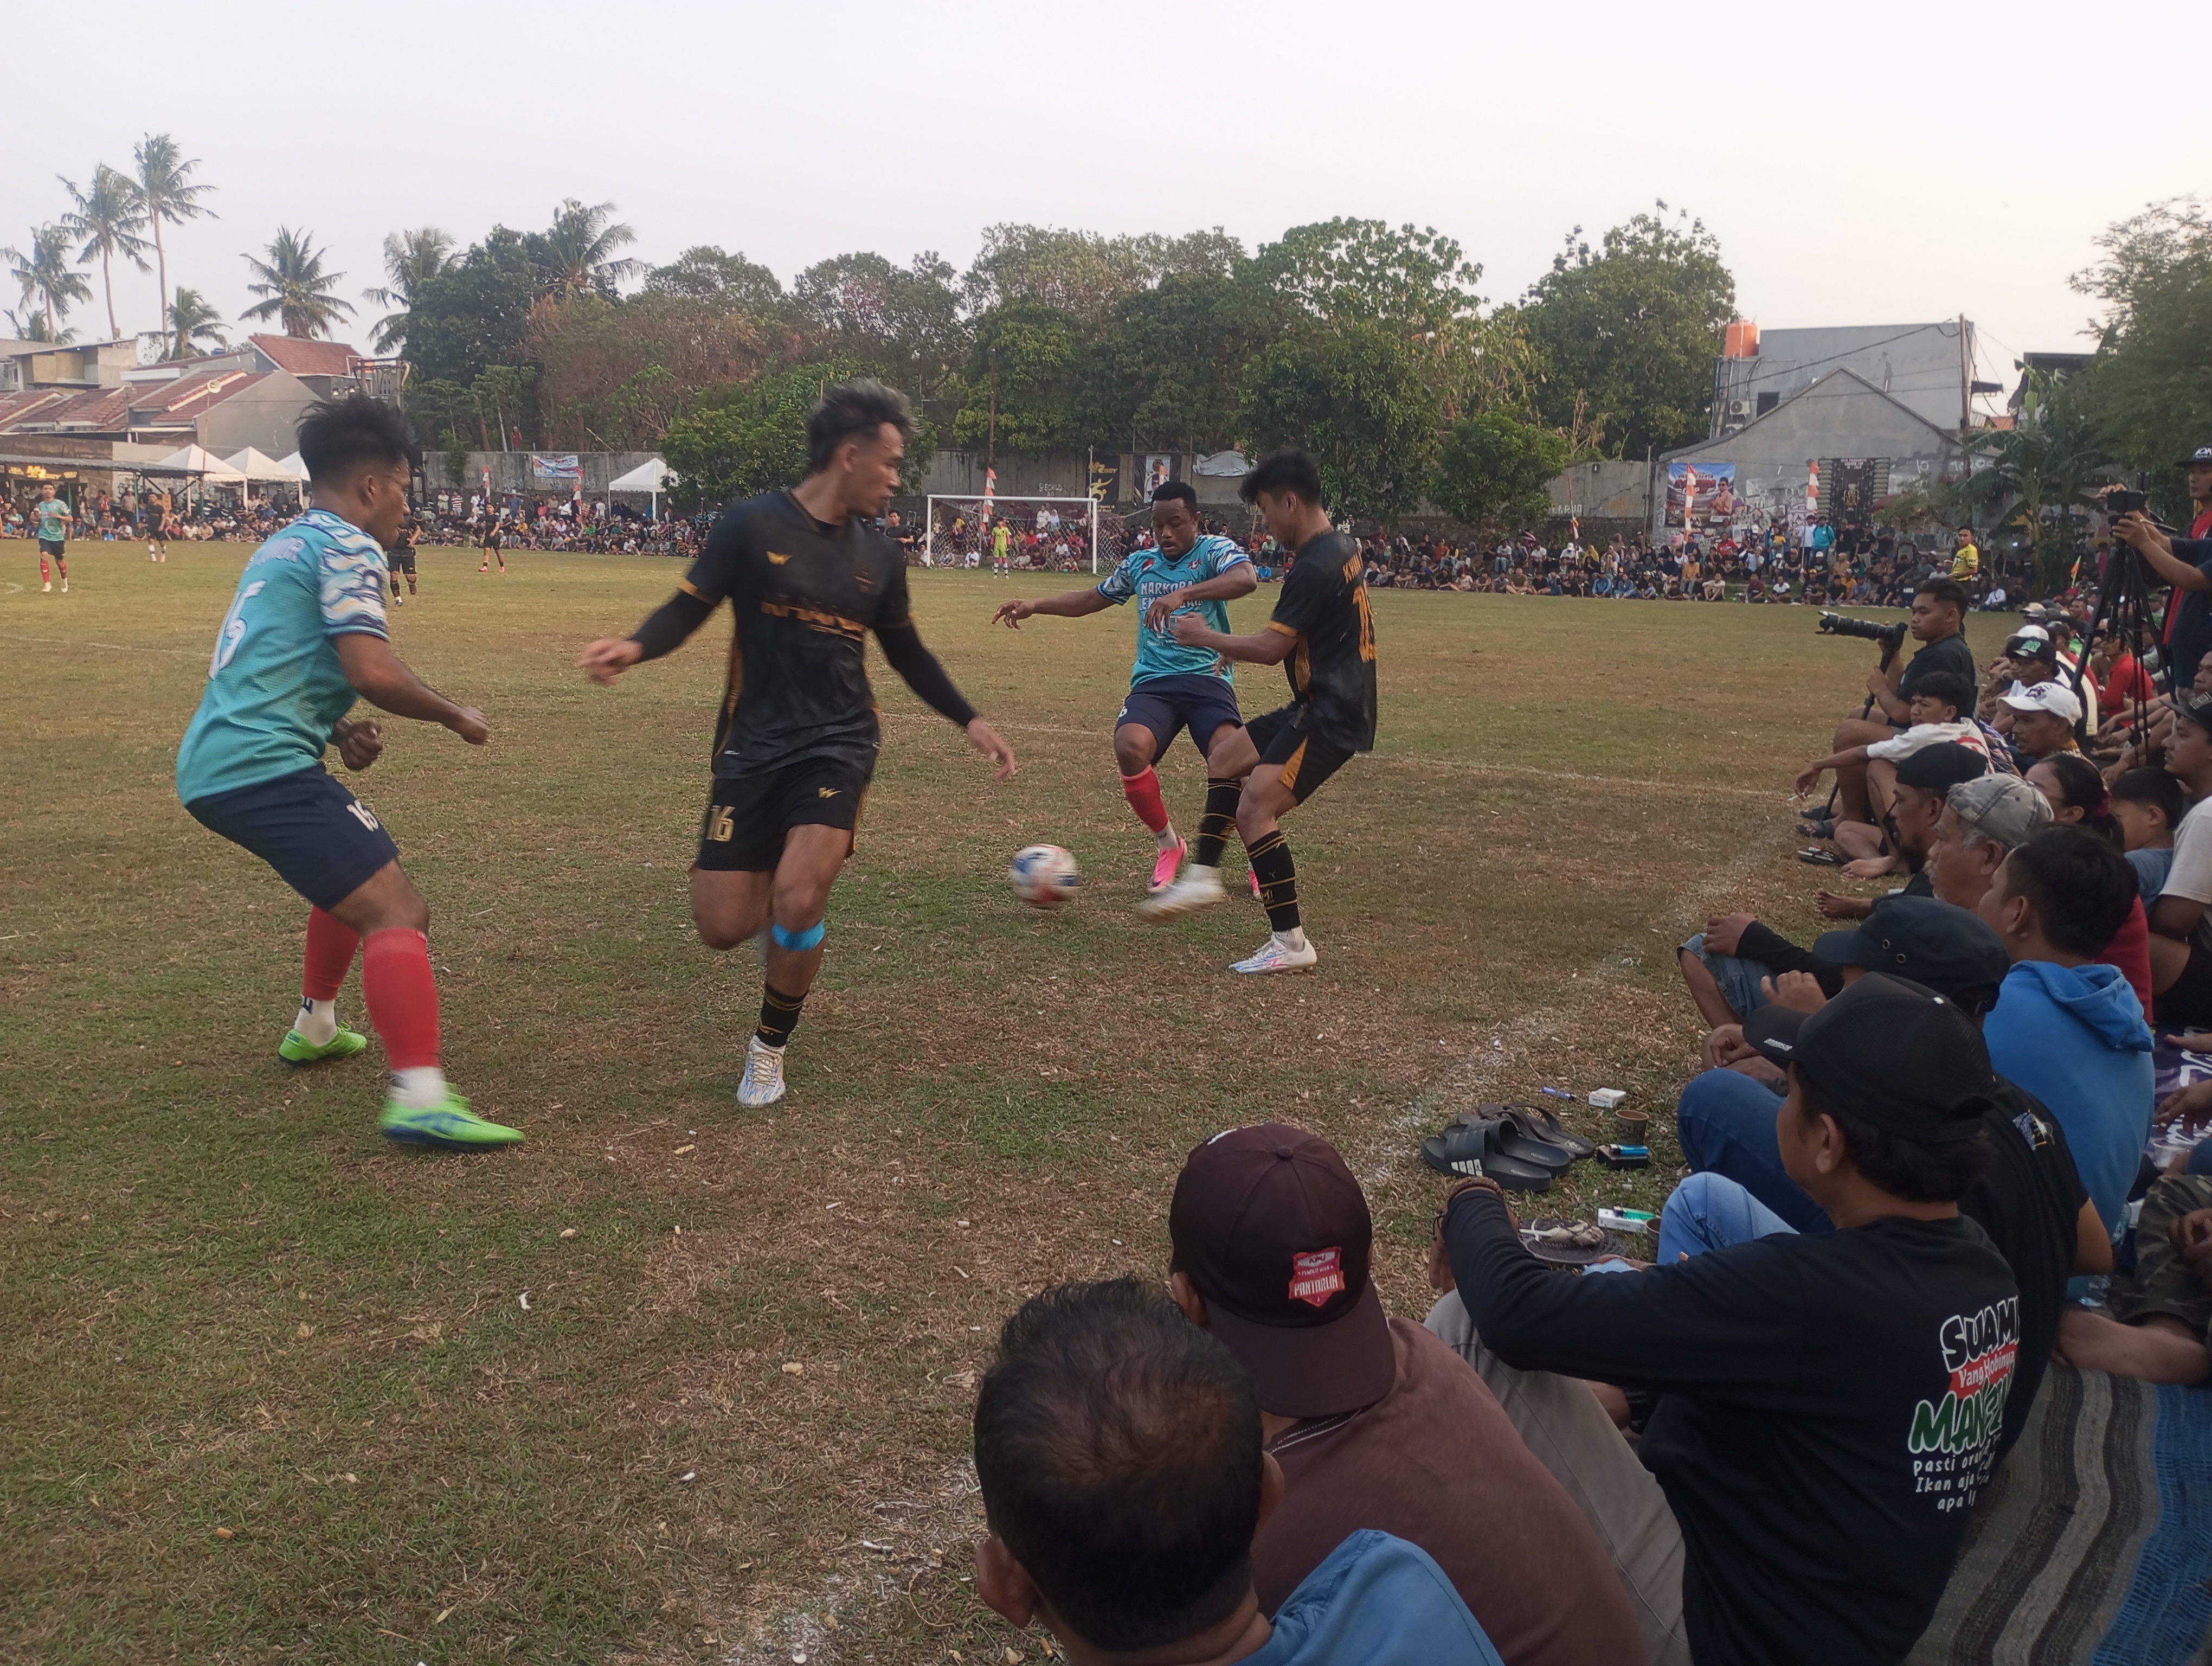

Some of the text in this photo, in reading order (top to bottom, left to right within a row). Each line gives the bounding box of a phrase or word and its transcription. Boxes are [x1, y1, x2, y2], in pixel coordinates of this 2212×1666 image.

[706, 805, 736, 842] 16
[1958, 1368, 1984, 1388] Yang
[1913, 1454, 1956, 1477] pasti
[1915, 1471, 1975, 1492] Ikan aja
[1937, 1496, 1964, 1513] apa
